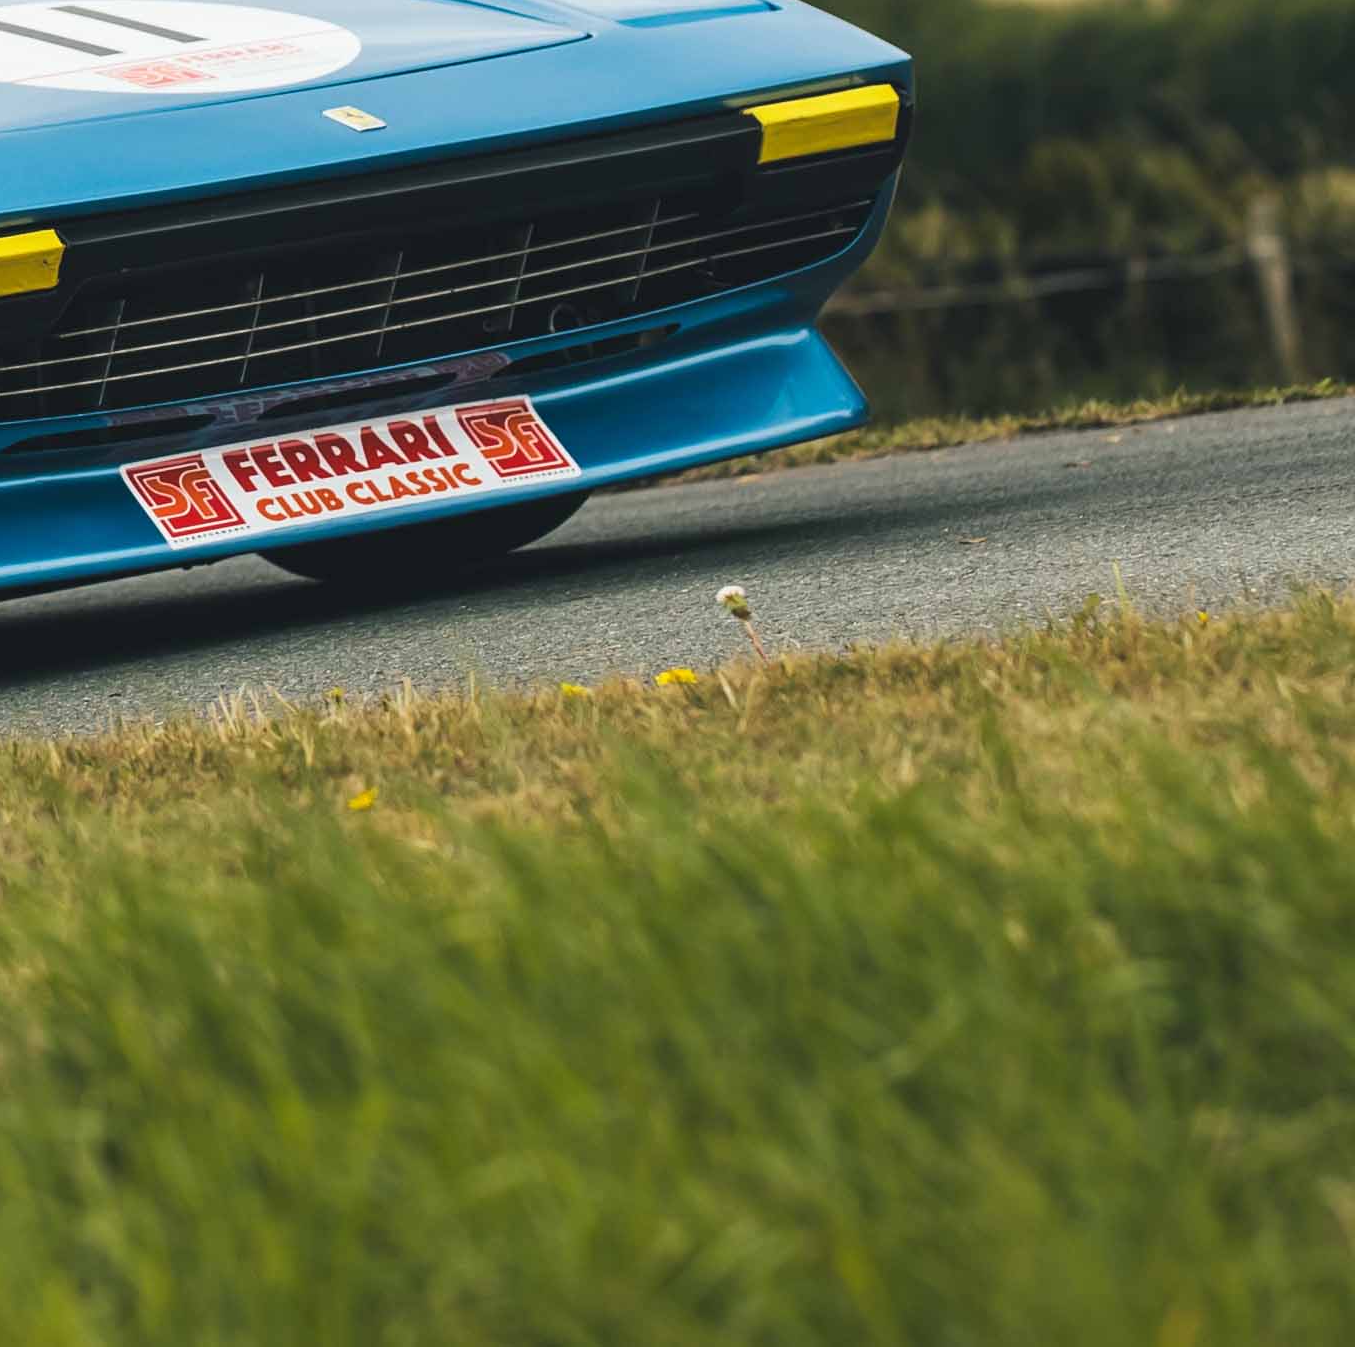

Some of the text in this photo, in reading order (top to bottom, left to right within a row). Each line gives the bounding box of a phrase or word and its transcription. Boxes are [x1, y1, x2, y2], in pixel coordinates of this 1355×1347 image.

[221, 415, 460, 493] FERRARI
[255, 462, 483, 522] CLUB CLASSIC
